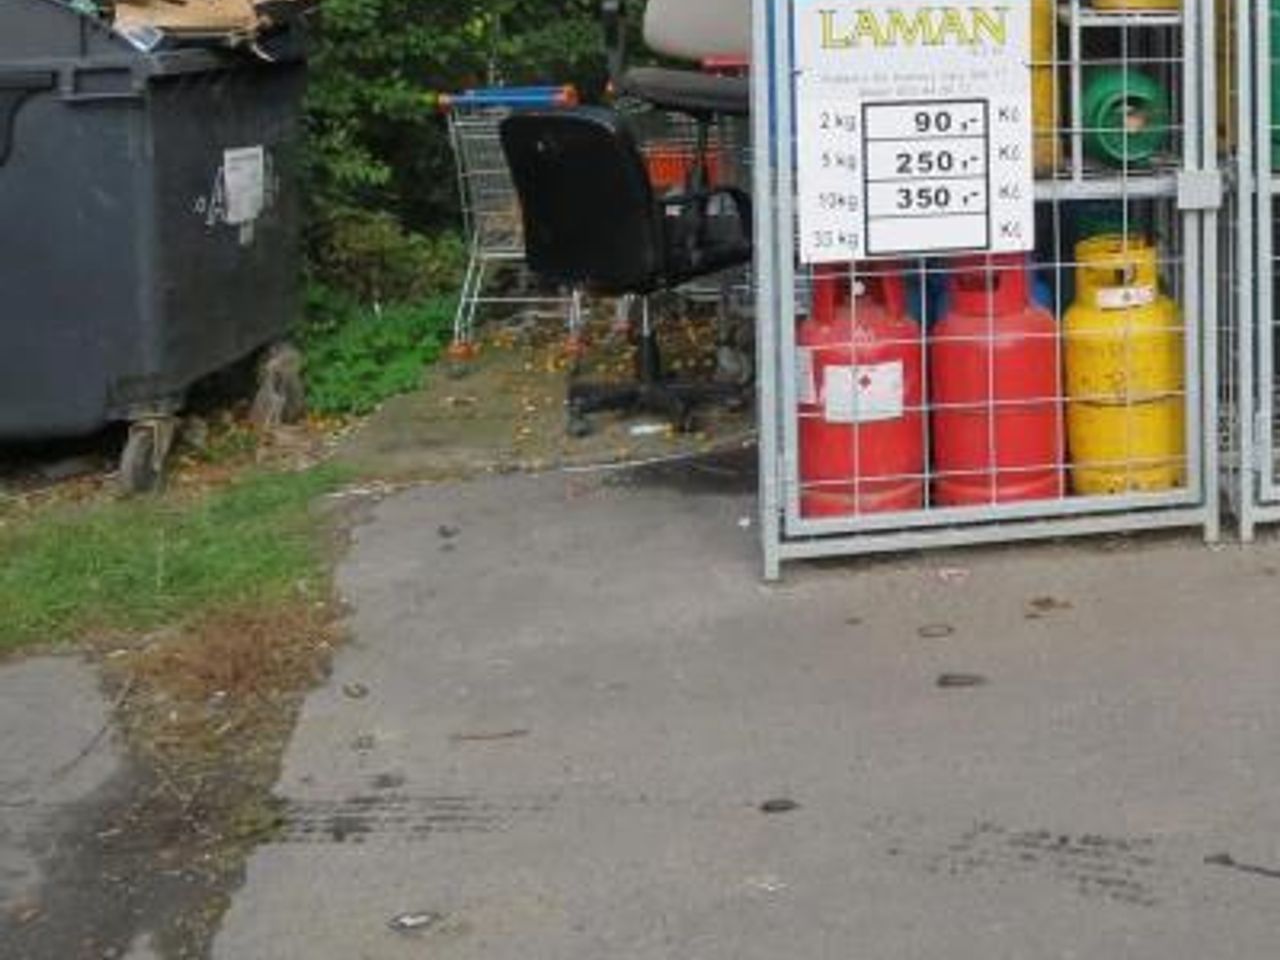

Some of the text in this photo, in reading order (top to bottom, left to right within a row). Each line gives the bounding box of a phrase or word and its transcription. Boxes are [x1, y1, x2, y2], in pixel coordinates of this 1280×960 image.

[818, 6, 1012, 50] LAMAN
[818, 111, 830, 130] 2
[835, 113, 857, 133] kg
